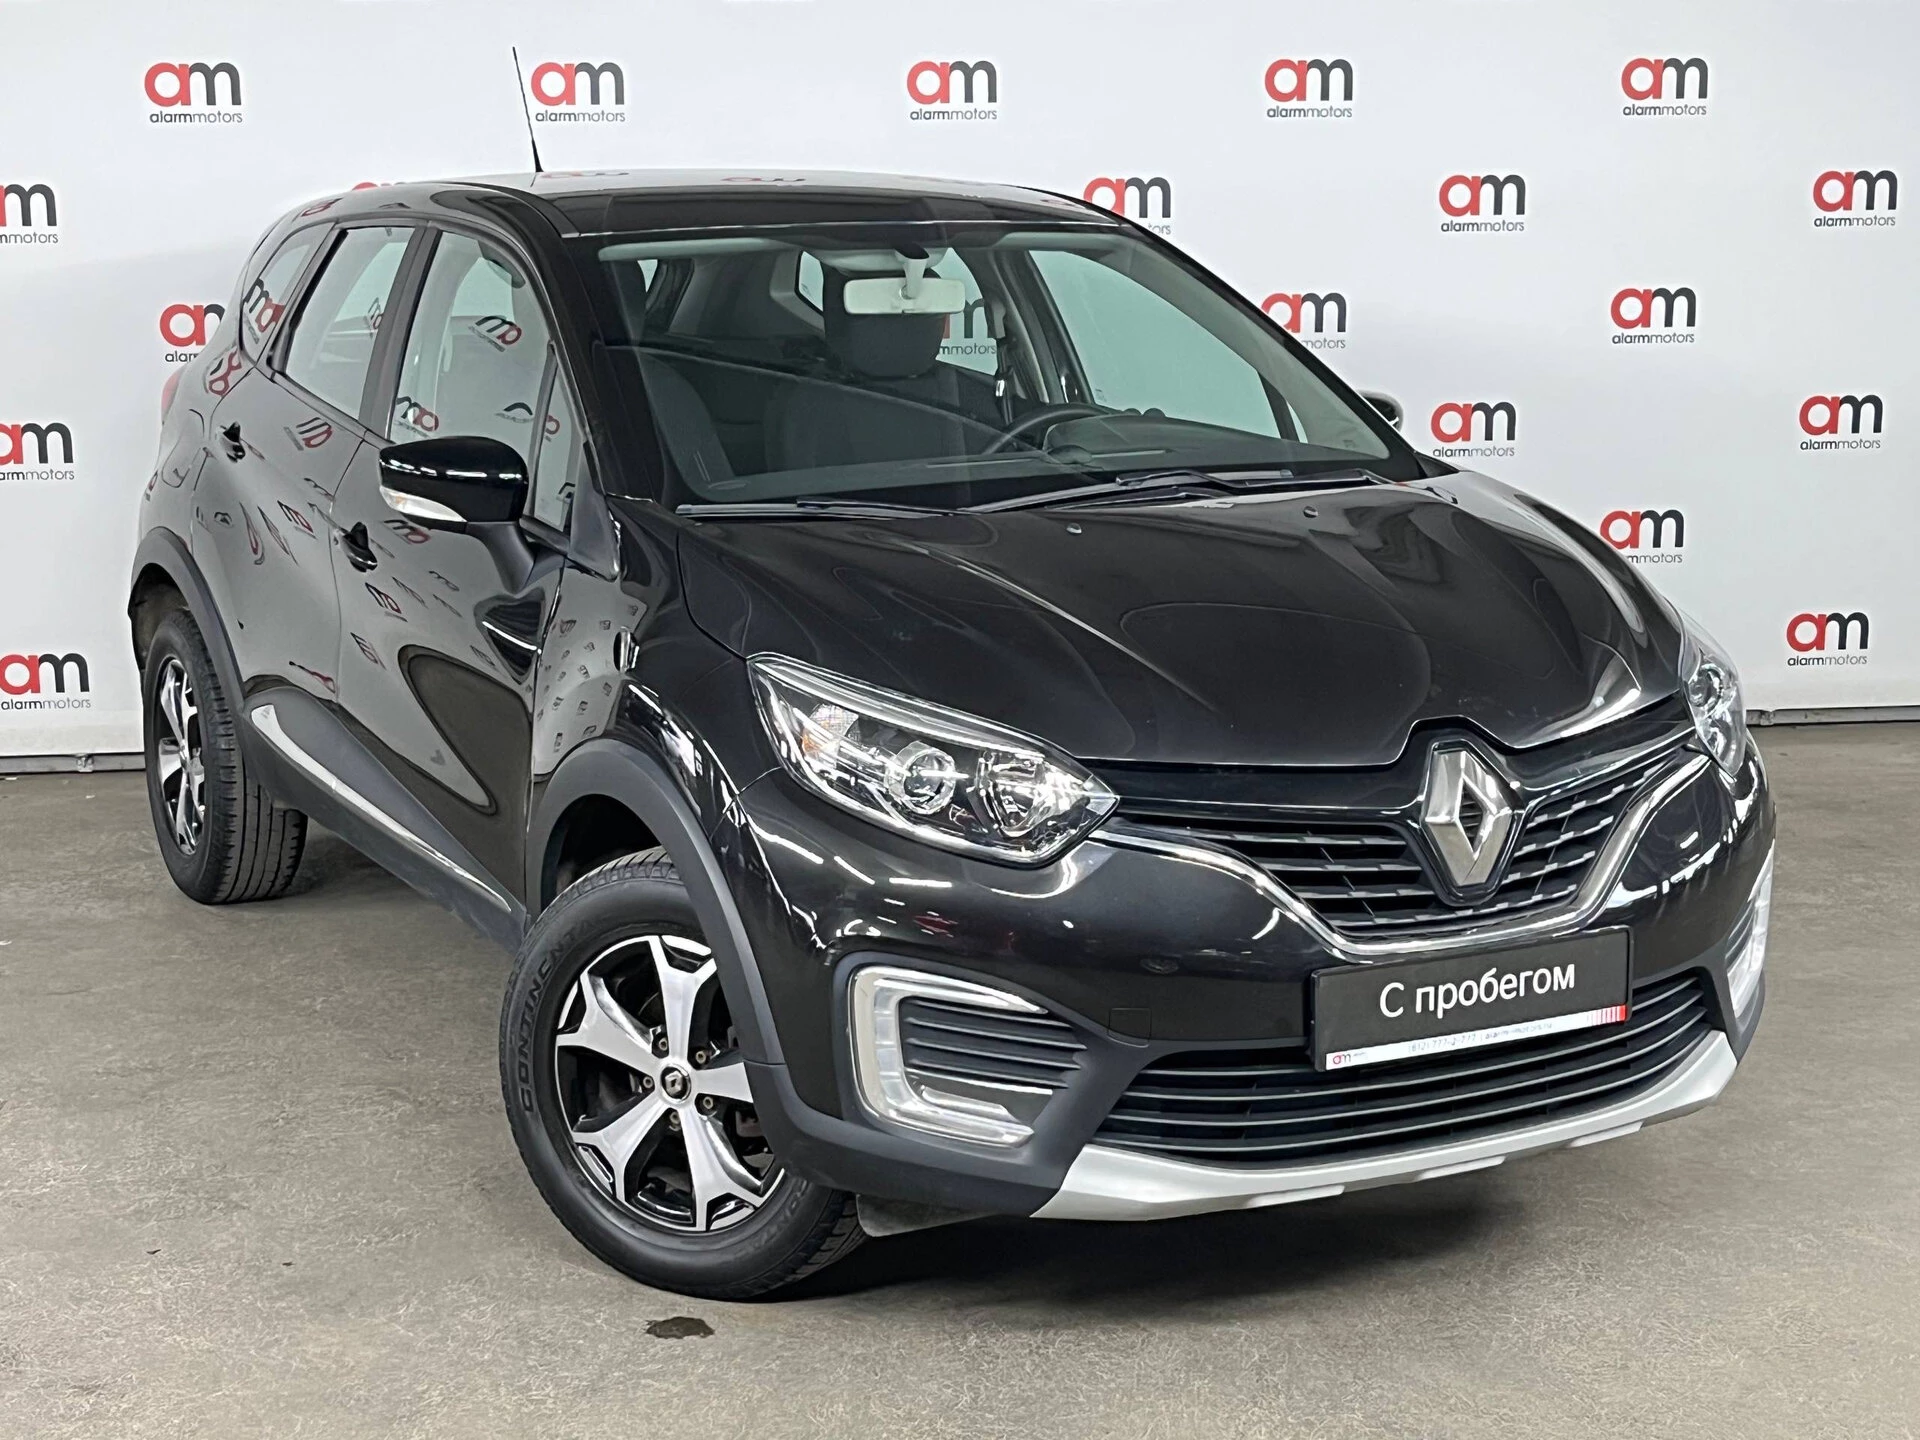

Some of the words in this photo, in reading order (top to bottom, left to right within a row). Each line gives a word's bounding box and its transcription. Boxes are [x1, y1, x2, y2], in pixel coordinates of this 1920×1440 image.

[144, 62, 241, 106] am
[531, 62, 624, 106] am
[907, 61, 997, 104] am
[1265, 59, 1353, 102] am
[1621, 58, 1708, 100] am
[150, 111, 242, 123] alarmmotors
[536, 110, 625, 122] alarmmotors
[910, 108, 997, 120] alarmmotors
[1267, 106, 1353, 118] alarmmotors
[1623, 104, 1707, 116] alarmmotors
[0, 184, 57, 227] m
[1083, 177, 1171, 217] am
[1439, 175, 1525, 217] am
[1813, 170, 1897, 212] am
[1441, 220, 1525, 232] alarmmotors
[1814, 215, 1896, 227] alarmmotors
[1261, 292, 1346, 333] am
[1611, 287, 1696, 329] am
[1612, 333, 1695, 345] alarmmotors
[1431, 402, 1516, 443] am
[1799, 395, 1883, 436] am
[1432, 446, 1515, 458] alarmmotors
[1800, 439, 1881, 451] alarmmotors
[0, 468, 75, 481] armmotors
[1600, 509, 1684, 549] am
[1787, 612, 1870, 652] am
[0, 653, 90, 695] am
[1788, 655, 1868, 667] alarmmotors
[1, 697, 91, 710] alarmmotors
[1379, 982, 1405, 1018] С
[1415, 963, 1575, 1019] пробегом
